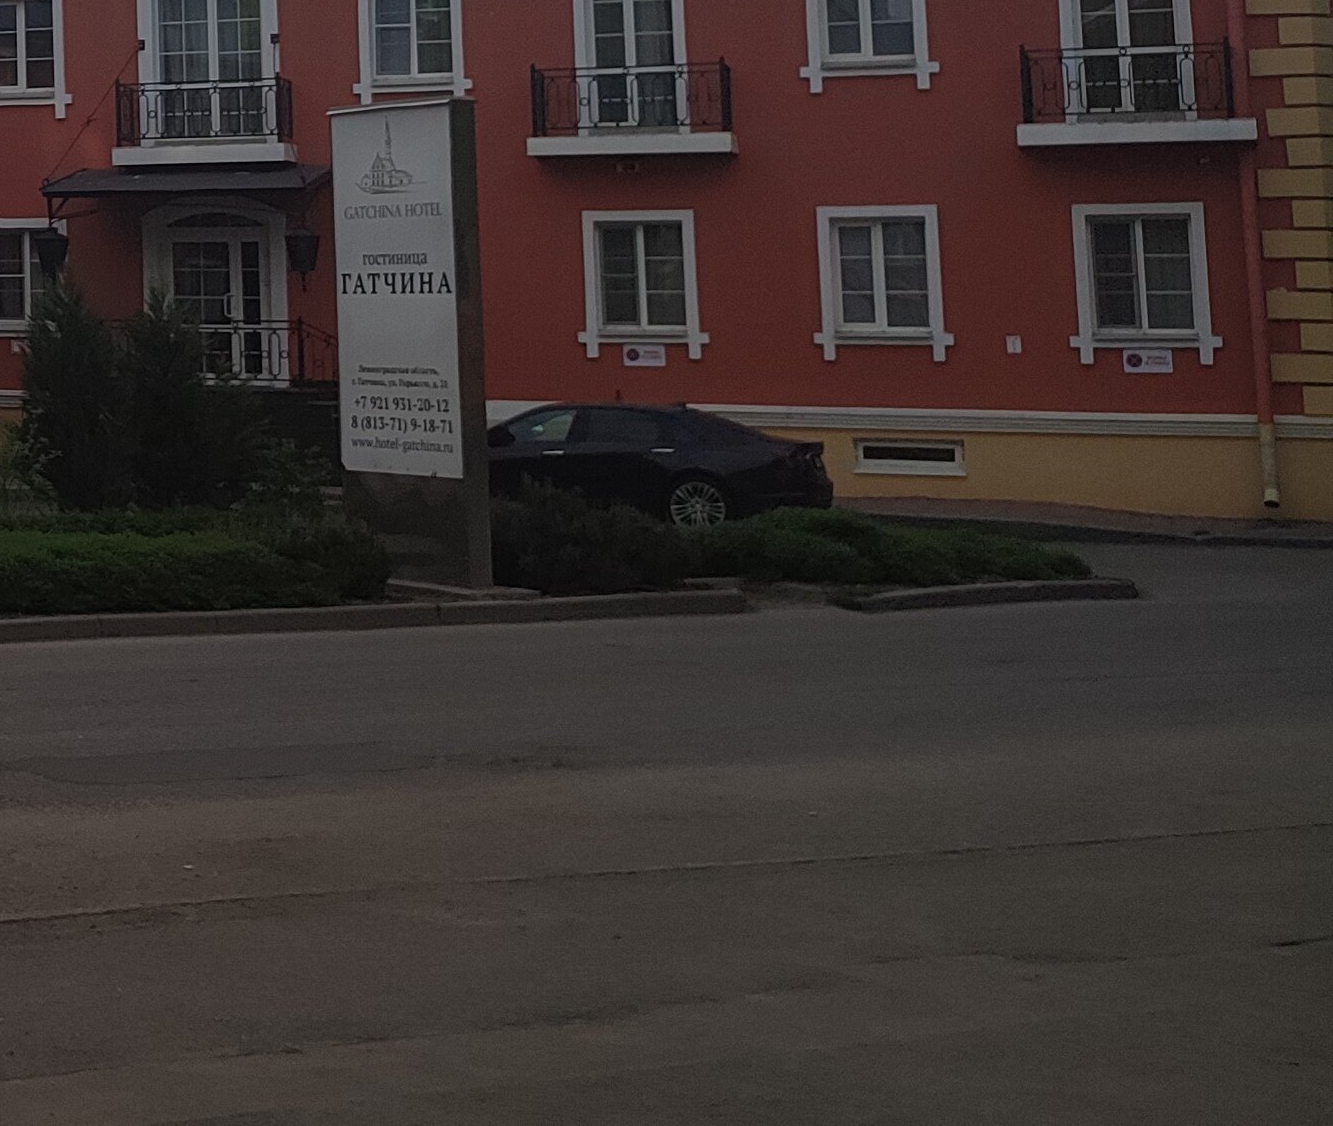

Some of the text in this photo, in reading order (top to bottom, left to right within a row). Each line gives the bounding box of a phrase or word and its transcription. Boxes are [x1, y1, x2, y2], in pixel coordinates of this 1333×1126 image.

[343, 202, 443, 220] GATCHINA HOTEL
[362, 252, 428, 267] гостиница
[341, 271, 453, 295] ГАТЧИНА
[354, 396, 450, 412] +7 921 931-20-12
[351, 415, 453, 434] 8 (813-71) 9-18-71
[351, 436, 453, 454] www.hotel-gatchina.ru
